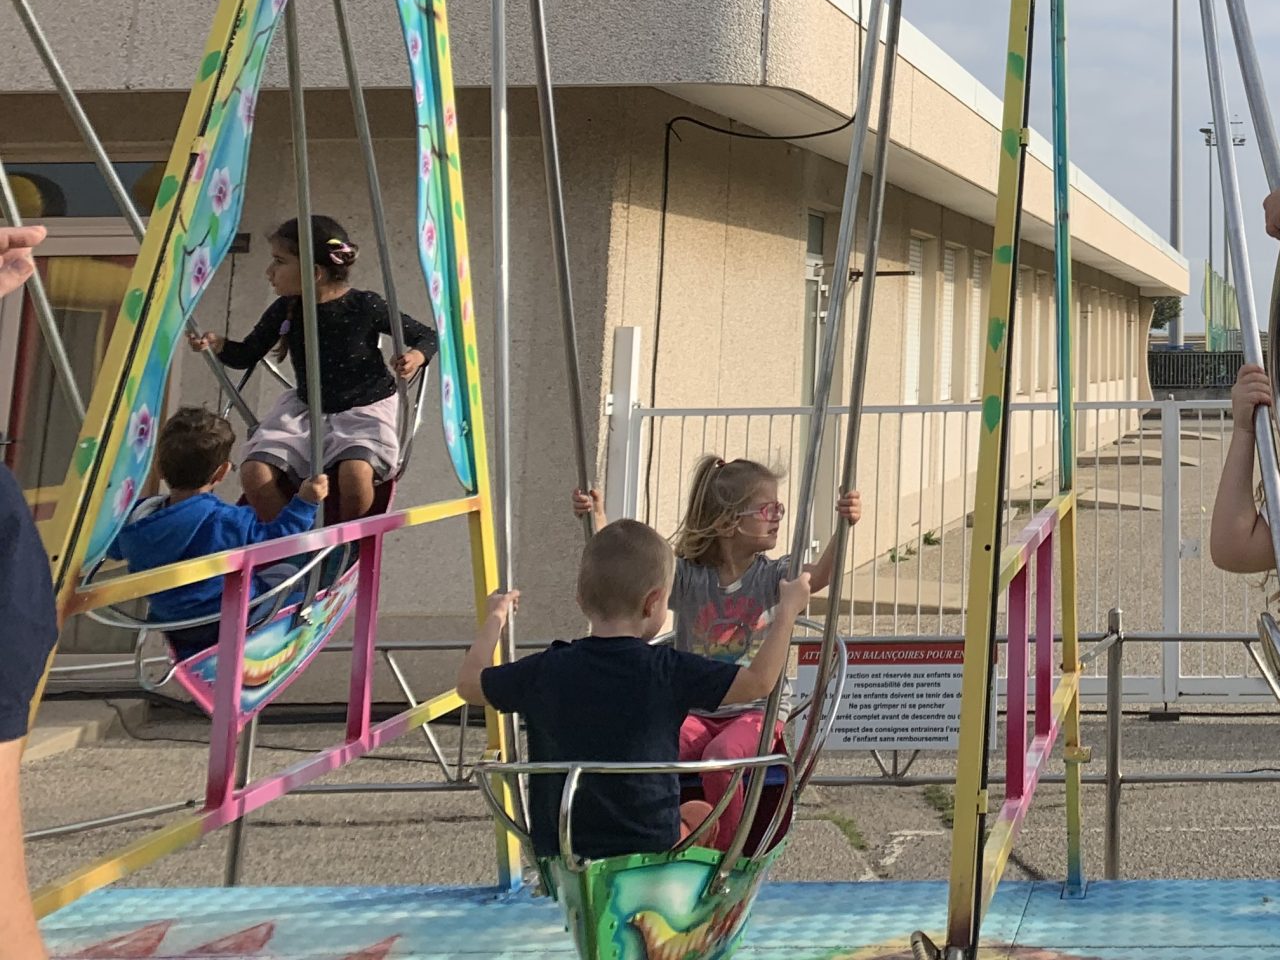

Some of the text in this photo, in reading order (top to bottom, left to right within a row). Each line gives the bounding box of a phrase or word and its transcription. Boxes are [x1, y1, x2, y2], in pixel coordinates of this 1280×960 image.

[802, 651, 861, 660] ATTON
[862, 650, 925, 662] BALANÇOIRES
[926, 650, 952, 659] POUR
[883, 671, 911, 679] réservée
[854, 681, 901, 689] responsabilité
[916, 681, 941, 689] parents
[942, 691, 954, 699] des
[873, 703, 899, 711] grimper
[918, 702, 945, 710] pencher
[835, 726, 860, 734] respect
[875, 726, 909, 734] consignes
